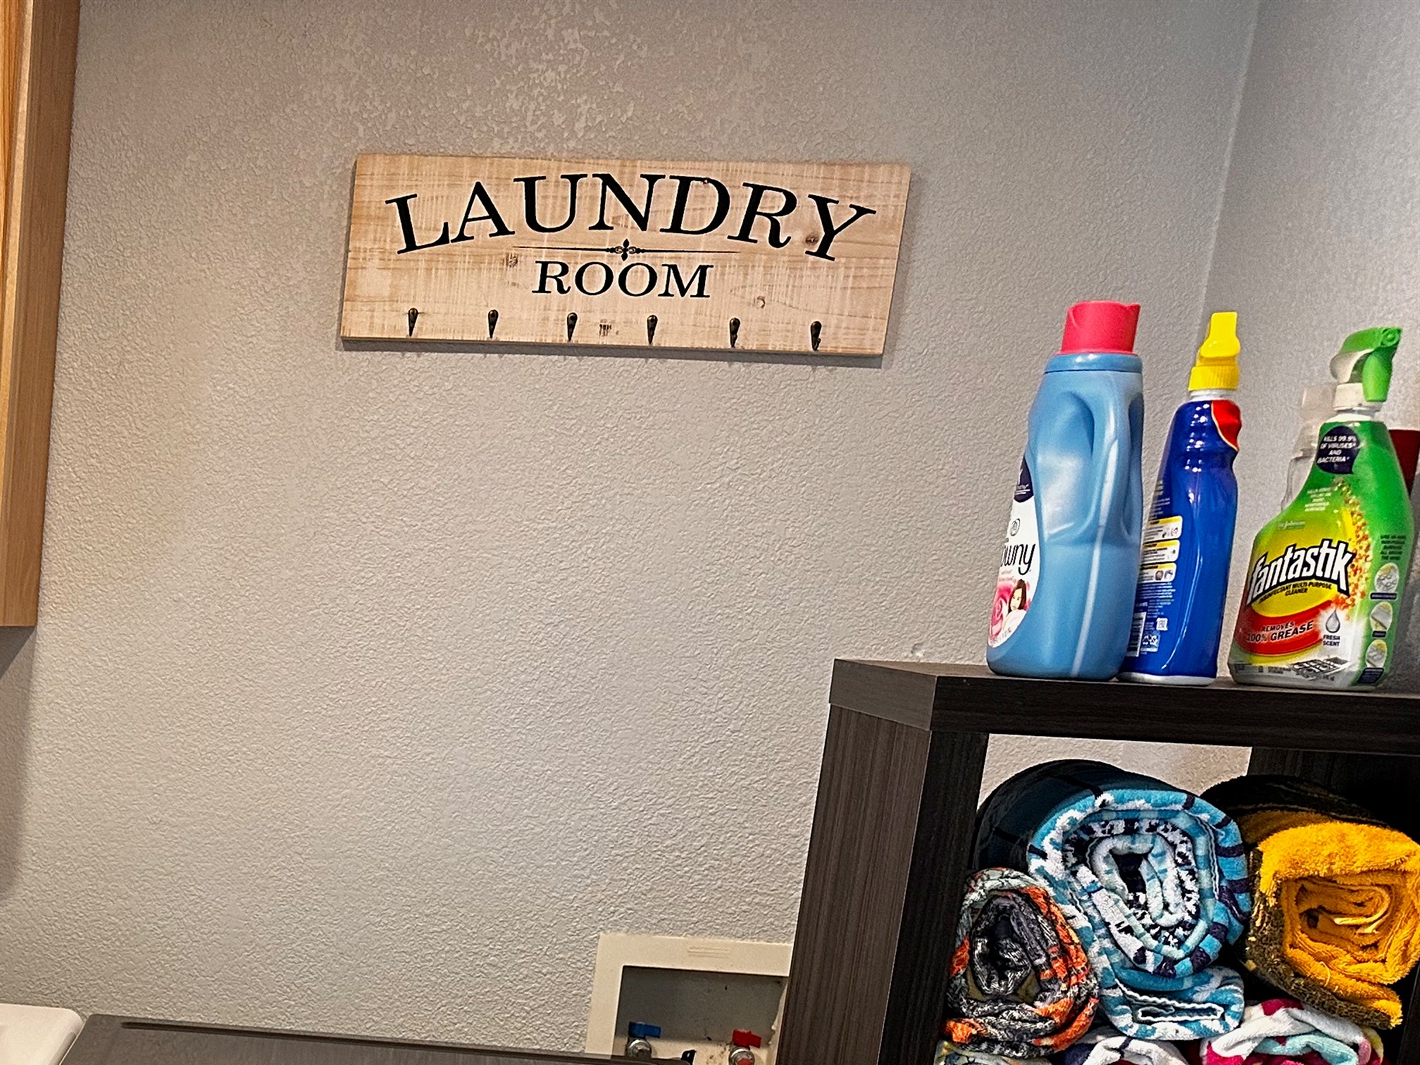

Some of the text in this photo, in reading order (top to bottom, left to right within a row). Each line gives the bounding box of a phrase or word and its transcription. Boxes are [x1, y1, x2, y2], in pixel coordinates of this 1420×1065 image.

[385, 173, 876, 261] LAUNDRY
[532, 260, 713, 298] ROOM
[1246, 539, 1355, 605] fantastik
[1285, 588, 1308, 596] CLEANER
[1262, 621, 1295, 632] REMOVES
[1270, 620, 1314, 641] GREASE
